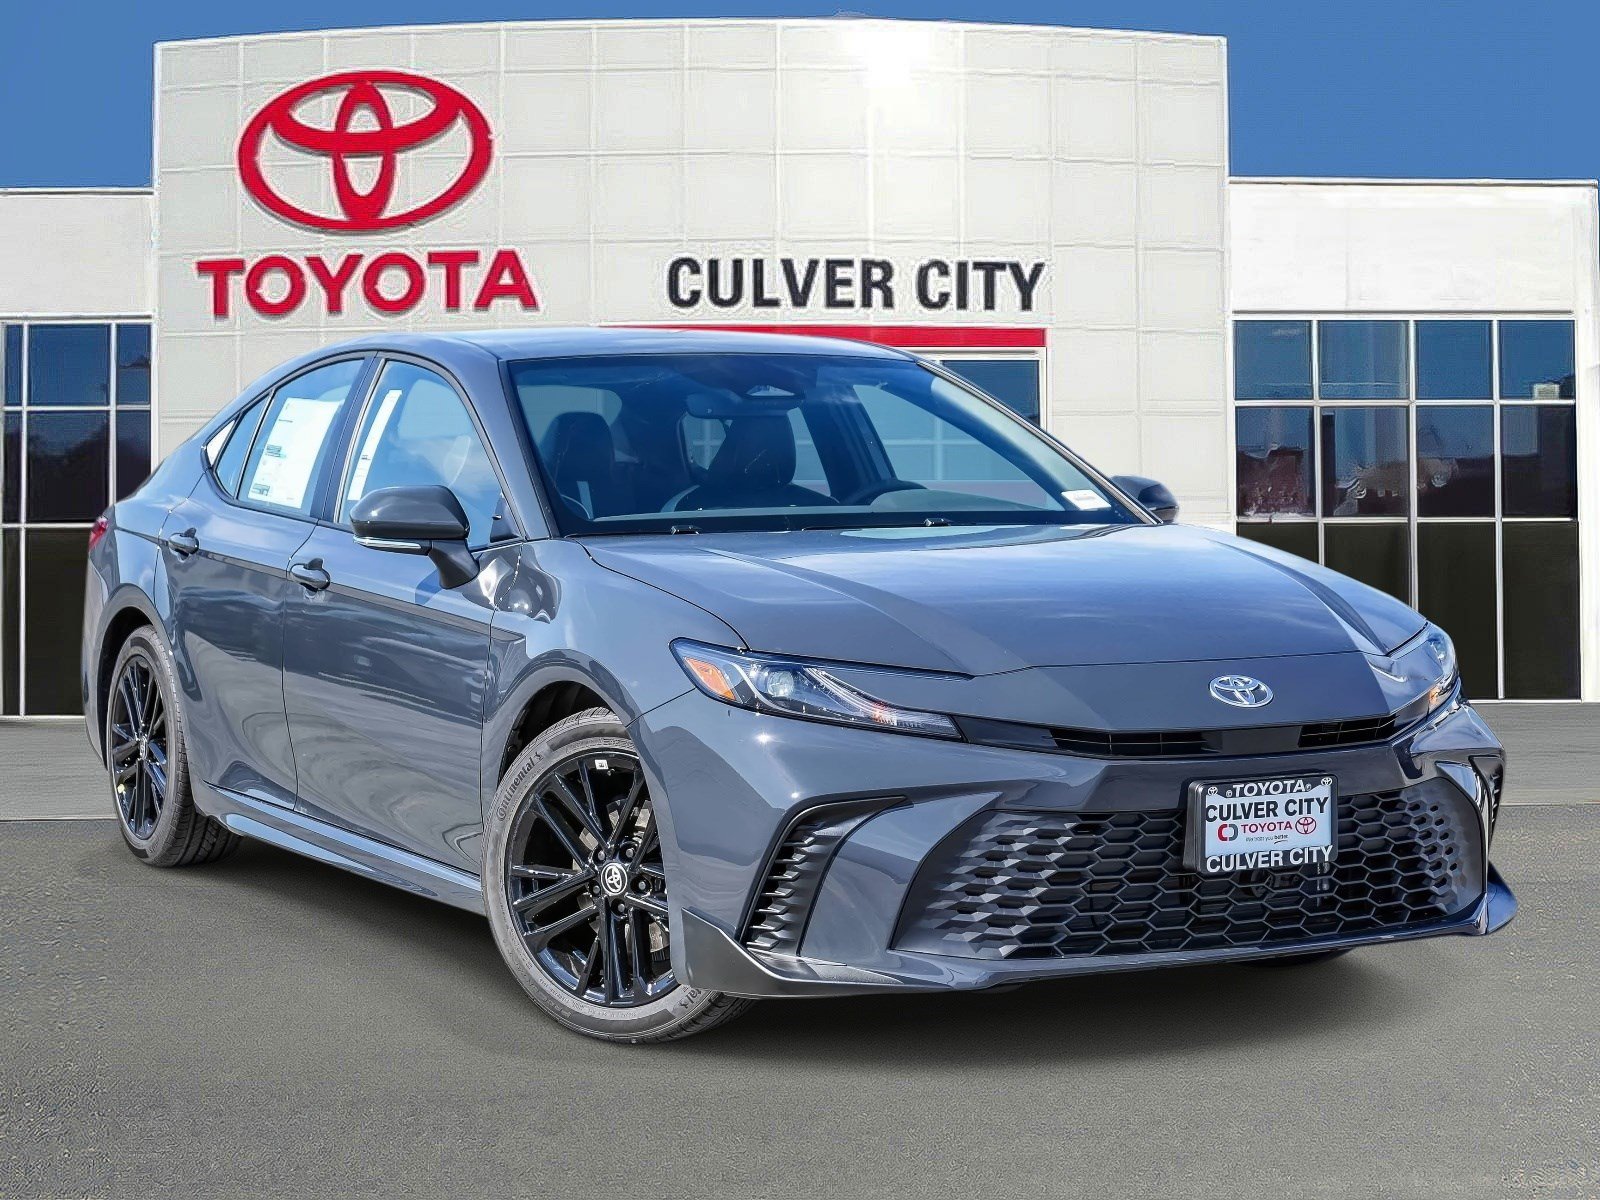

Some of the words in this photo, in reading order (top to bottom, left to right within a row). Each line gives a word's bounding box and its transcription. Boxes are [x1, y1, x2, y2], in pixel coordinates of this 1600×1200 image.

[197, 249, 539, 318] TOYOTA
[667, 256, 894, 309] CULVER
[916, 259, 1045, 311] CITY
[497, 756, 535, 821] Continental
[1233, 779, 1305, 798] TOYOTA
[1206, 801, 1279, 822] CULVER
[1284, 797, 1329, 817] CITY
[1241, 821, 1293, 834] TOYOTA
[1206, 850, 1284, 873] CULVER
[1289, 845, 1333, 865] CITY
